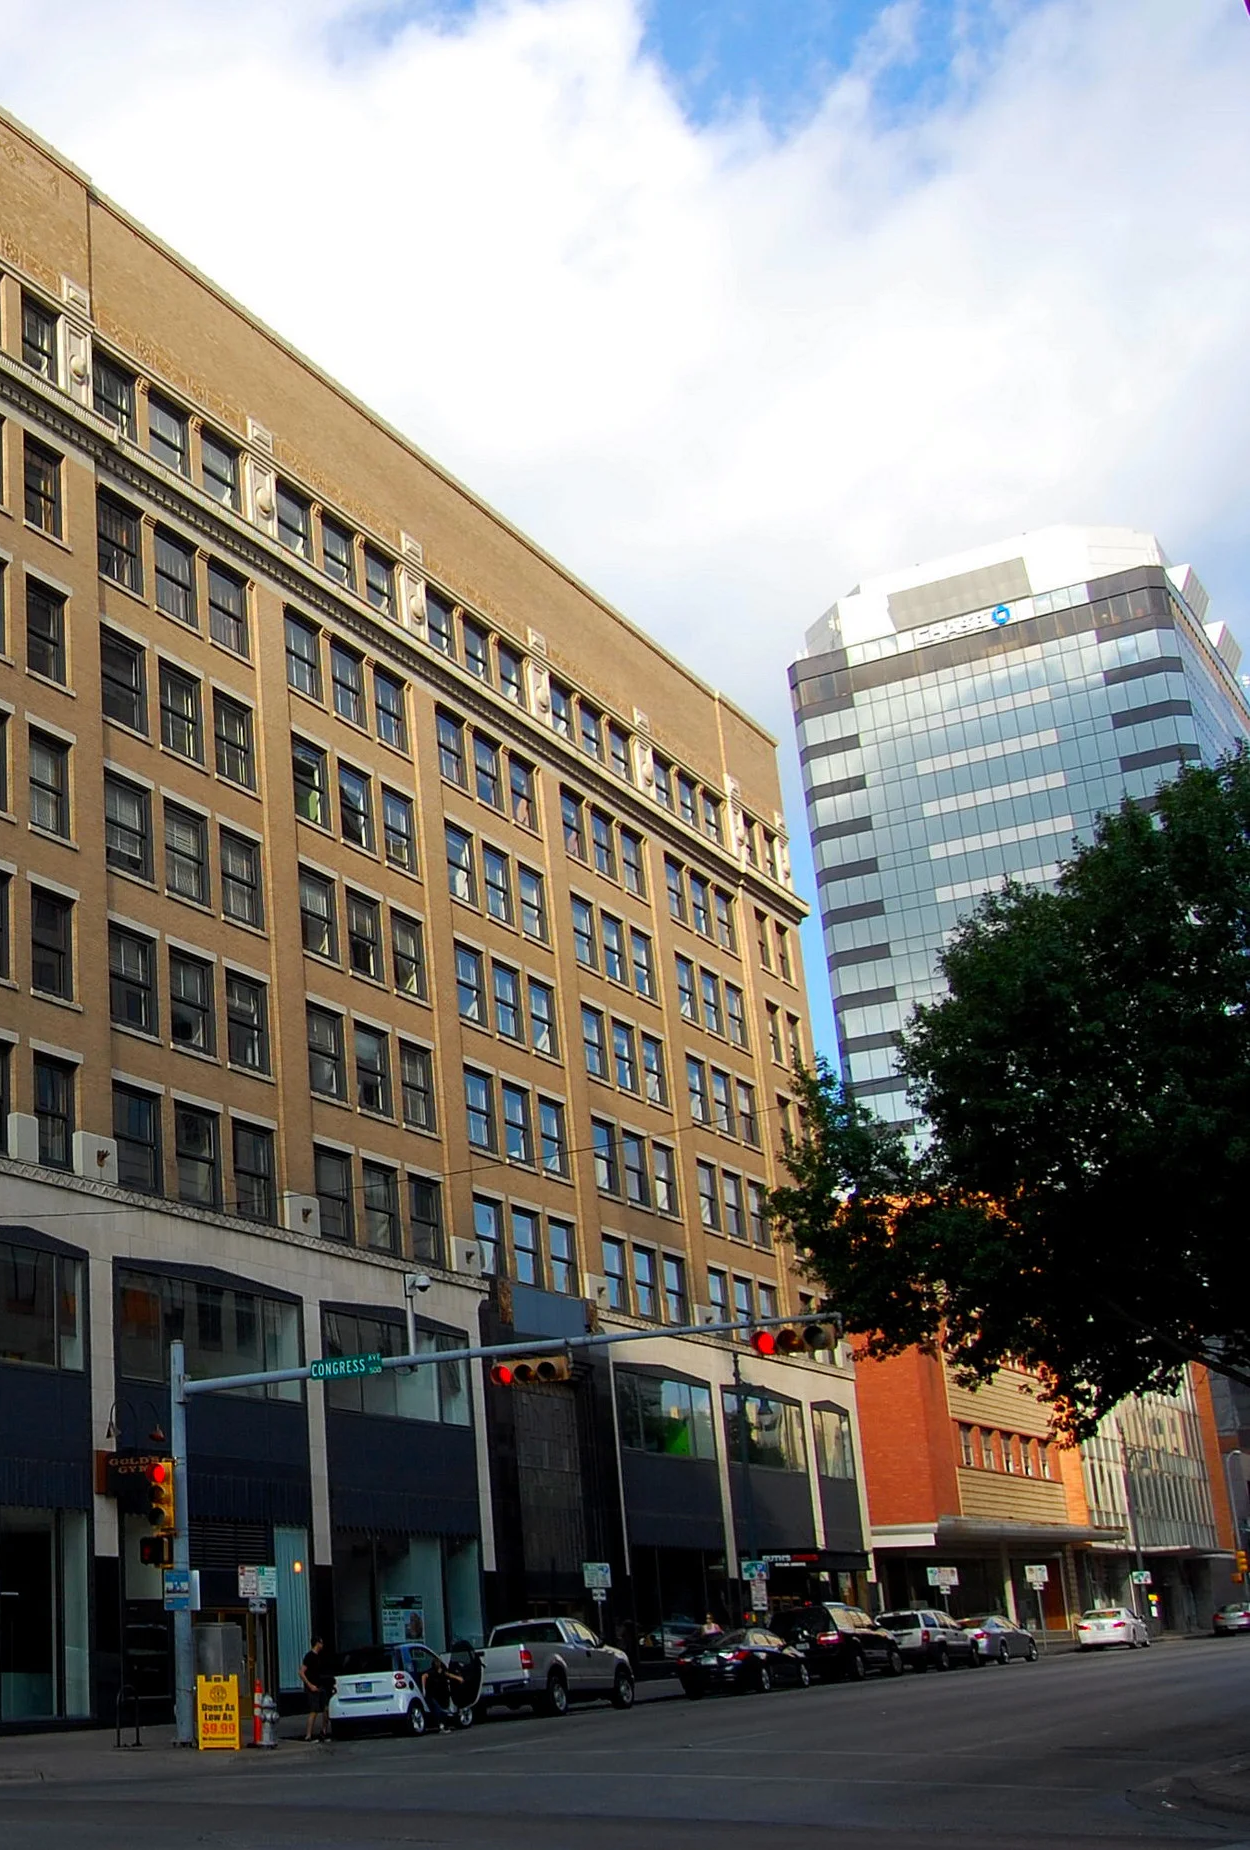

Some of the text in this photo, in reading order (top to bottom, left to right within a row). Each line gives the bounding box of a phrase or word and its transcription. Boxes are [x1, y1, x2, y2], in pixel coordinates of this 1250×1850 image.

[311, 1359, 366, 1377] CONGRESS
[204, 1712, 221, 1721] Low
[202, 1722, 236, 1735] $9.99
